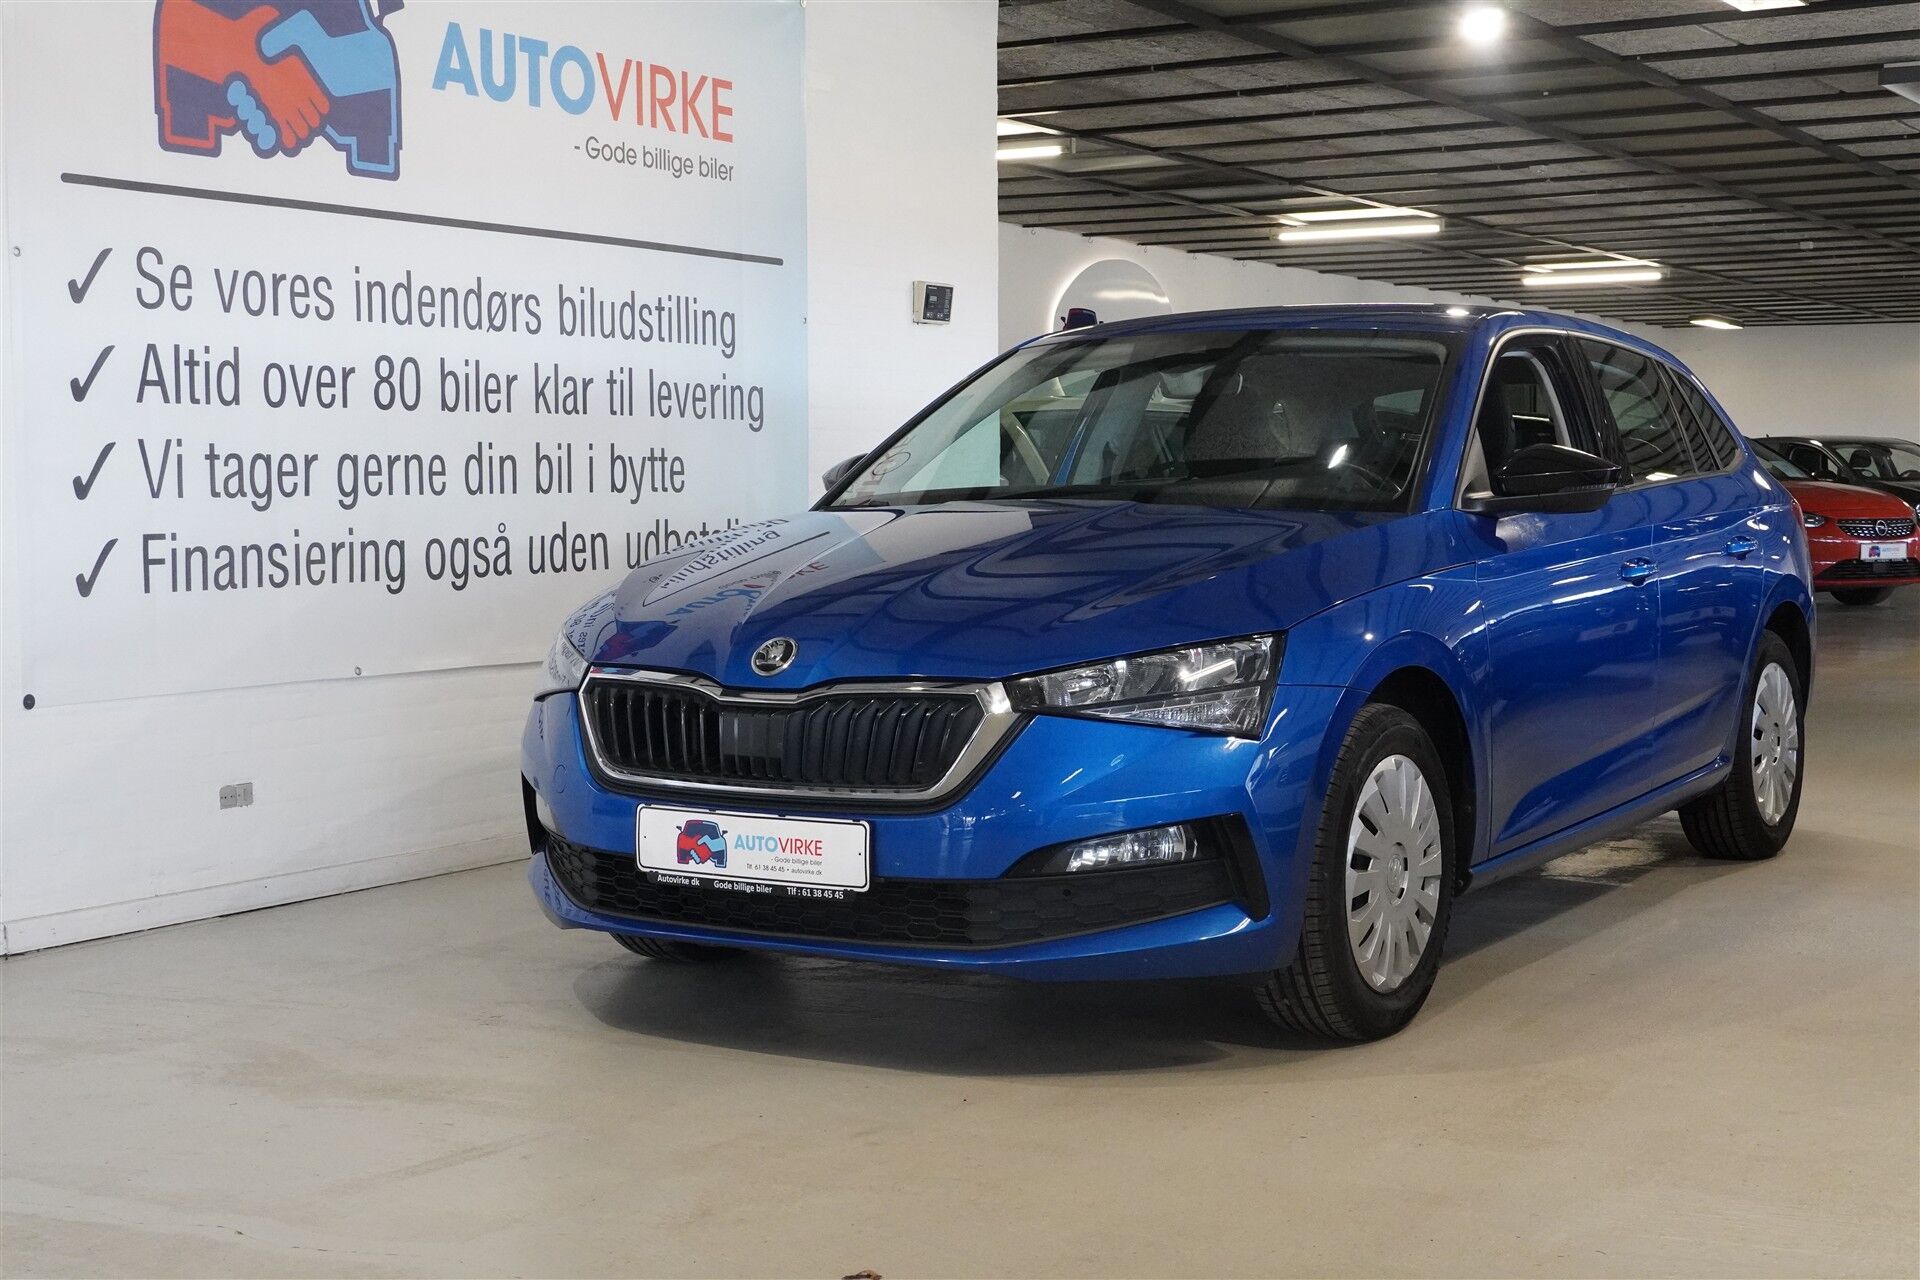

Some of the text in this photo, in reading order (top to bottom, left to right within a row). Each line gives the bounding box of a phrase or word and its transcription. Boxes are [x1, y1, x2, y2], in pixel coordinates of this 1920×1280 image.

[432, 21, 734, 144] AUTOVIRKE
[585, 136, 637, 166] Gode
[642, 145, 694, 179] billige
[698, 155, 734, 182] biler
[135, 245, 736, 360] Se vores indendørs biludstilling
[136, 342, 766, 433] Altid over 80 biler klar til levering
[136, 437, 686, 513] Vi tager gerne din bil i bytte
[141, 527, 406, 597] Finansiering
[425, 522, 512, 593] også
[528, 521, 610, 577] uden
[734, 834, 823, 857] AUTOVIRKE
[713, 880, 773, 893] Gode billige biler
[801, 888, 811, 897] 61
[812, 889, 822, 898] 38
[823, 890, 833, 898] 45
[834, 891, 844, 899] 45
